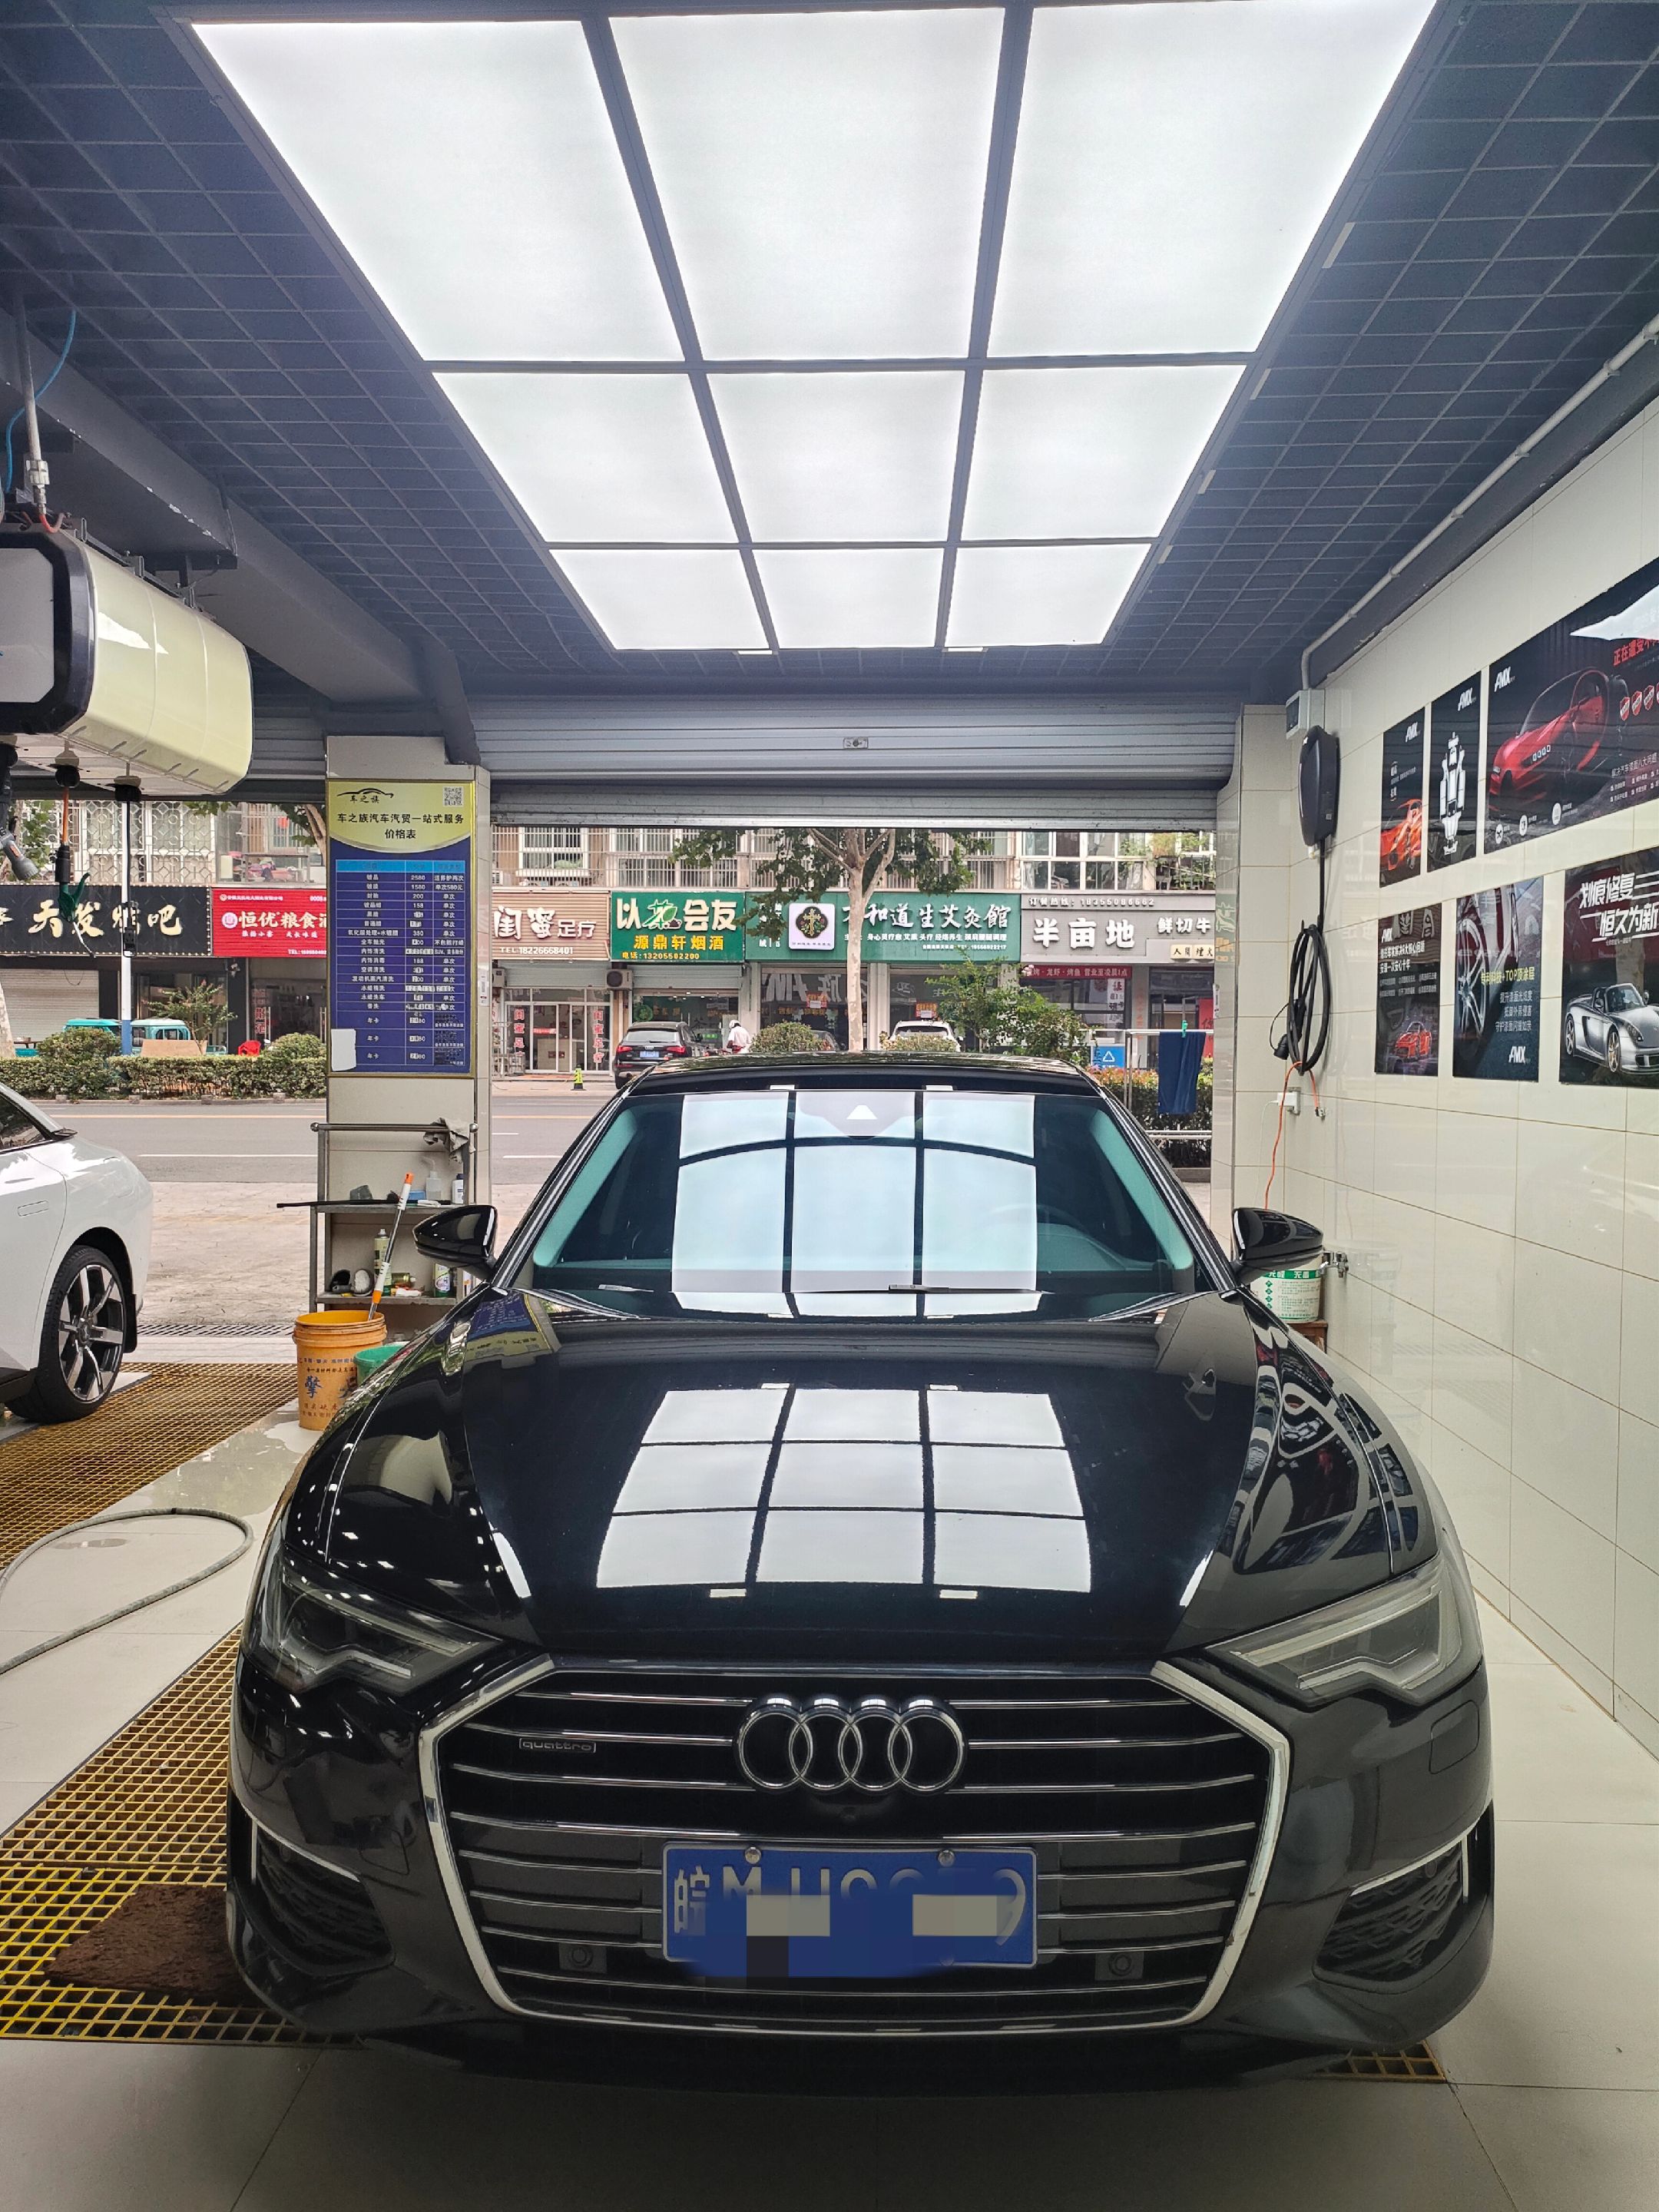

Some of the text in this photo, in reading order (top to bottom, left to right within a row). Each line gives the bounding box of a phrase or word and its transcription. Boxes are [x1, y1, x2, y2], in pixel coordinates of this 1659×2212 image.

[338, 813, 464, 824] 车之族汽车汽贸一站式服务
[385, 830, 416, 839] 价格表
[1579, 873, 1634, 909] 划痕修复
[493, 906, 597, 941] 闺蜜足疗
[616, 898, 737, 932] 以茶会友
[1157, 917, 1211, 935] 鲜切牛
[1600, 902, 1659, 936] 恒久为新
[634, 935, 724, 951] 源鼎轩烟酒
[1033, 917, 1135, 949] 半亩地
[522, 1740, 592, 1751] quattro
